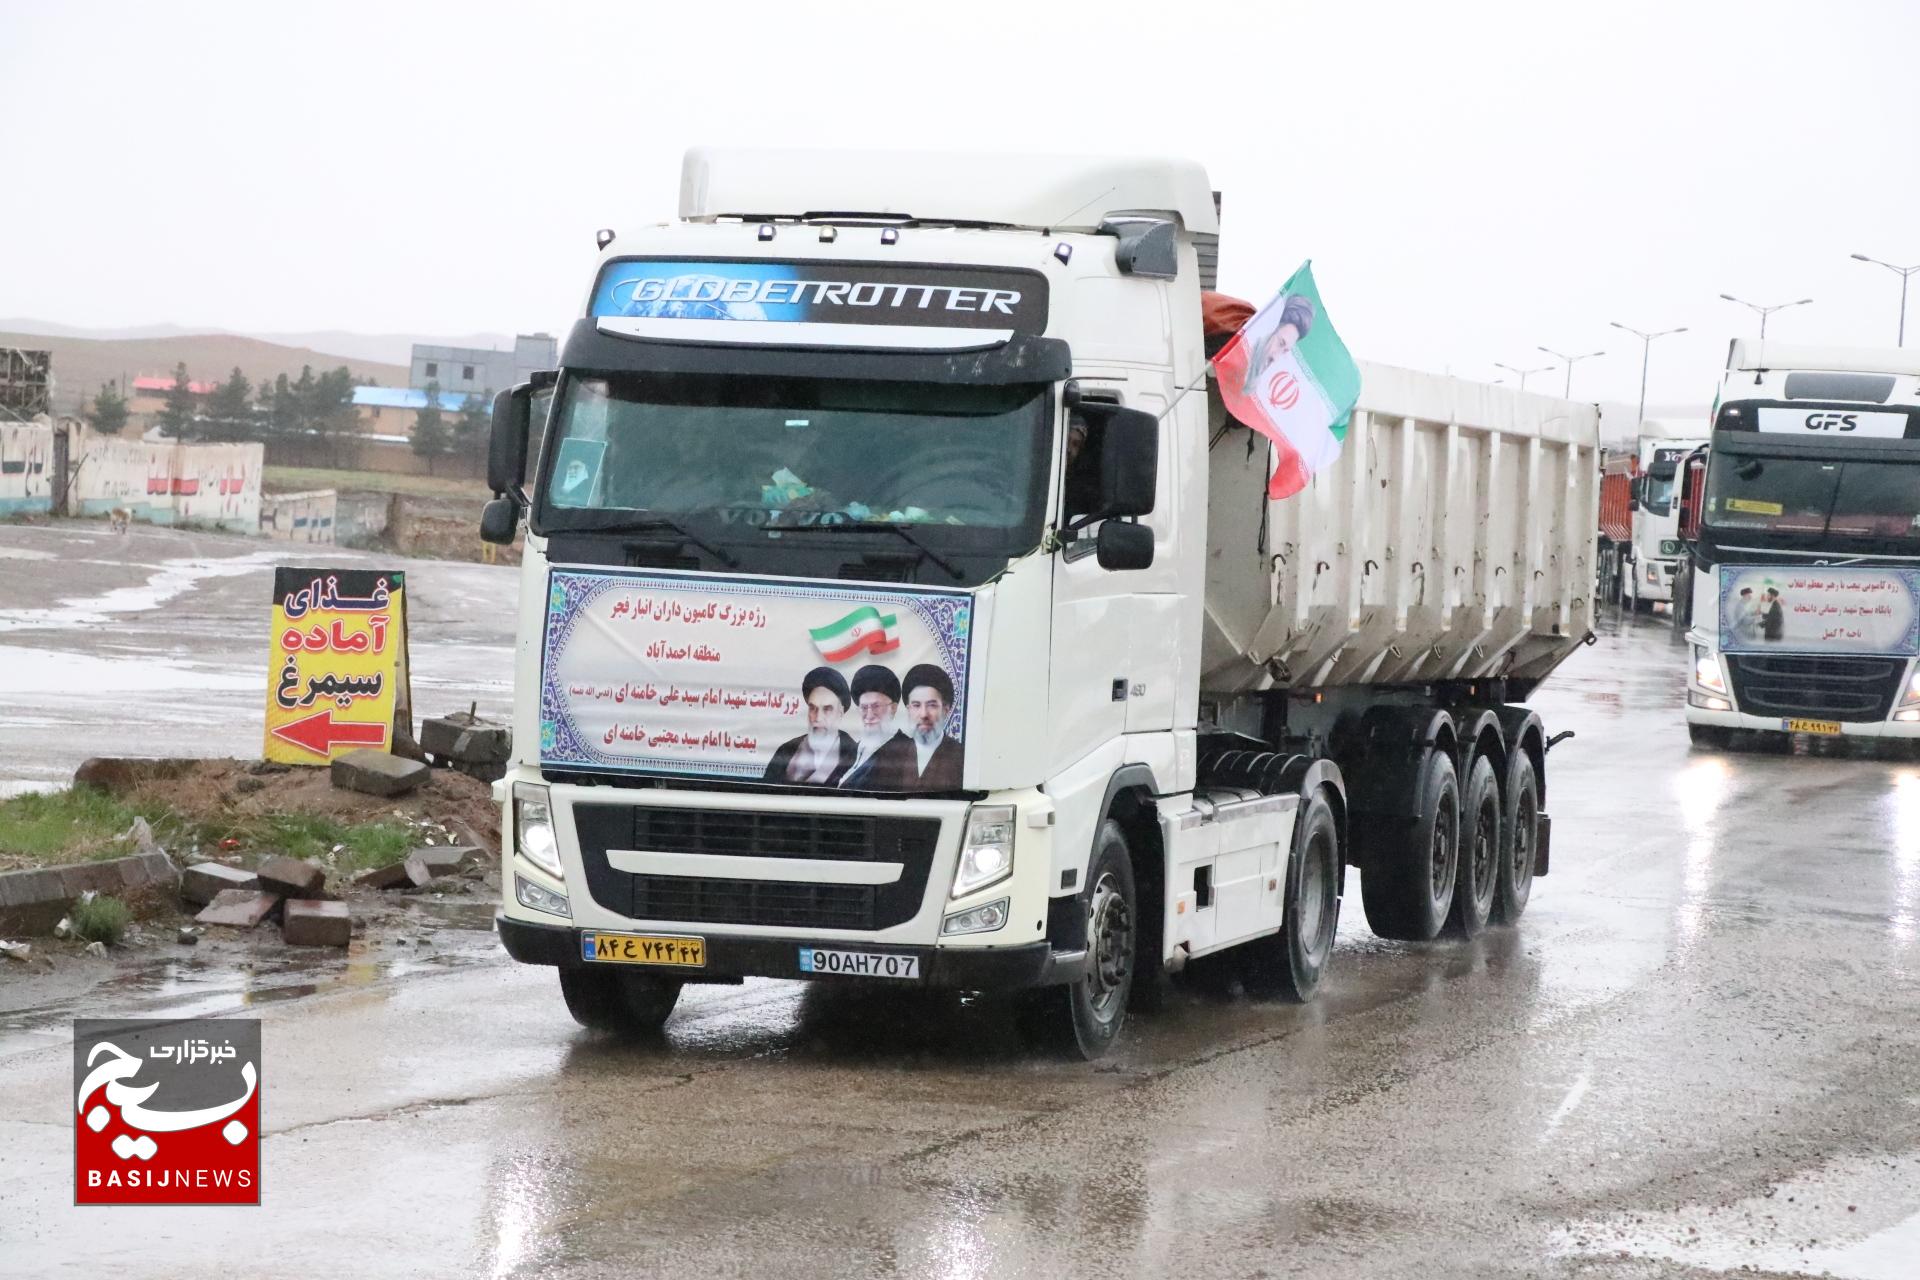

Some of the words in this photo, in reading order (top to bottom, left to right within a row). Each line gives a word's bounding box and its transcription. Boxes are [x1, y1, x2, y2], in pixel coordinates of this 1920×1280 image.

[630, 277, 1021, 315] GLOBETROTTER
[1805, 413, 1858, 432] GFS
[283, 575, 391, 619] غذای
[610, 596, 630, 619] فجر
[631, 598, 653, 620] انبار
[654, 600, 682, 622] داران
[683, 602, 718, 624] کامیون
[719, 604, 747, 627] بزرگ
[748, 606, 767, 628] رژه
[281, 615, 391, 652] آماده
[693, 642, 721, 662] منطقه
[277, 654, 384, 709] سیمرغ
[615, 682, 629, 703] ای
[630, 682, 657, 700] خامنه
[659, 684, 680, 706] علی
[681, 689, 700, 708] سید
[702, 687, 722, 709] امام
[724, 689, 748, 710] شهید
[603, 722, 618, 745] ای
[619, 724, 646, 741] خامنه
[648, 728, 679, 748] مجتبی
[681, 732, 700, 750] سید
[702, 730, 722, 751] امام
[724, 730, 731, 752] با
[733, 734, 757, 753] بیعت
[813, 951, 916, 977] 90AH707
